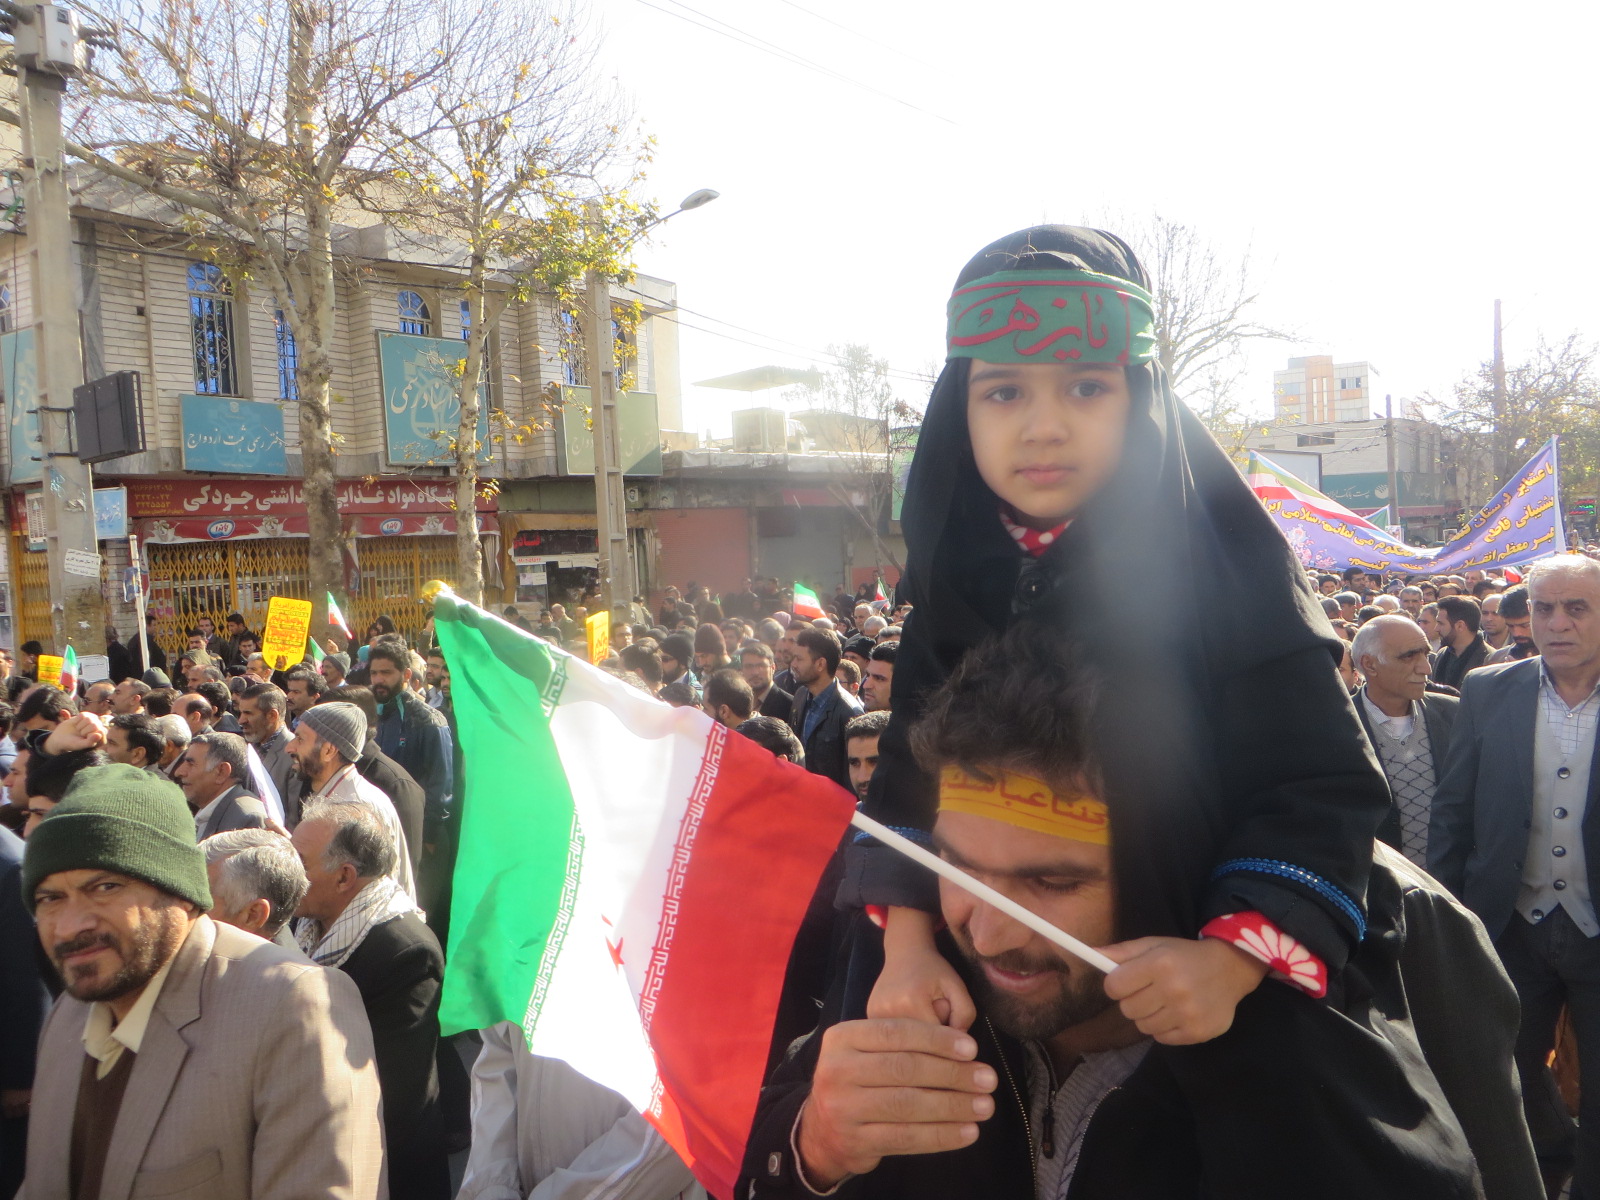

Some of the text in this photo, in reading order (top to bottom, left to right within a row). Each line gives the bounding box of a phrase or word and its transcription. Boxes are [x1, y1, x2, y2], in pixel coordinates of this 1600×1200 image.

[187, 428, 221, 449] ازدواج
[223, 424, 247, 453] ثبت
[183, 484, 254, 512] جودکی
[387, 485, 415, 509] مواد
[1262, 496, 1283, 513] ایرا
[1281, 506, 1321, 525] سلامی
